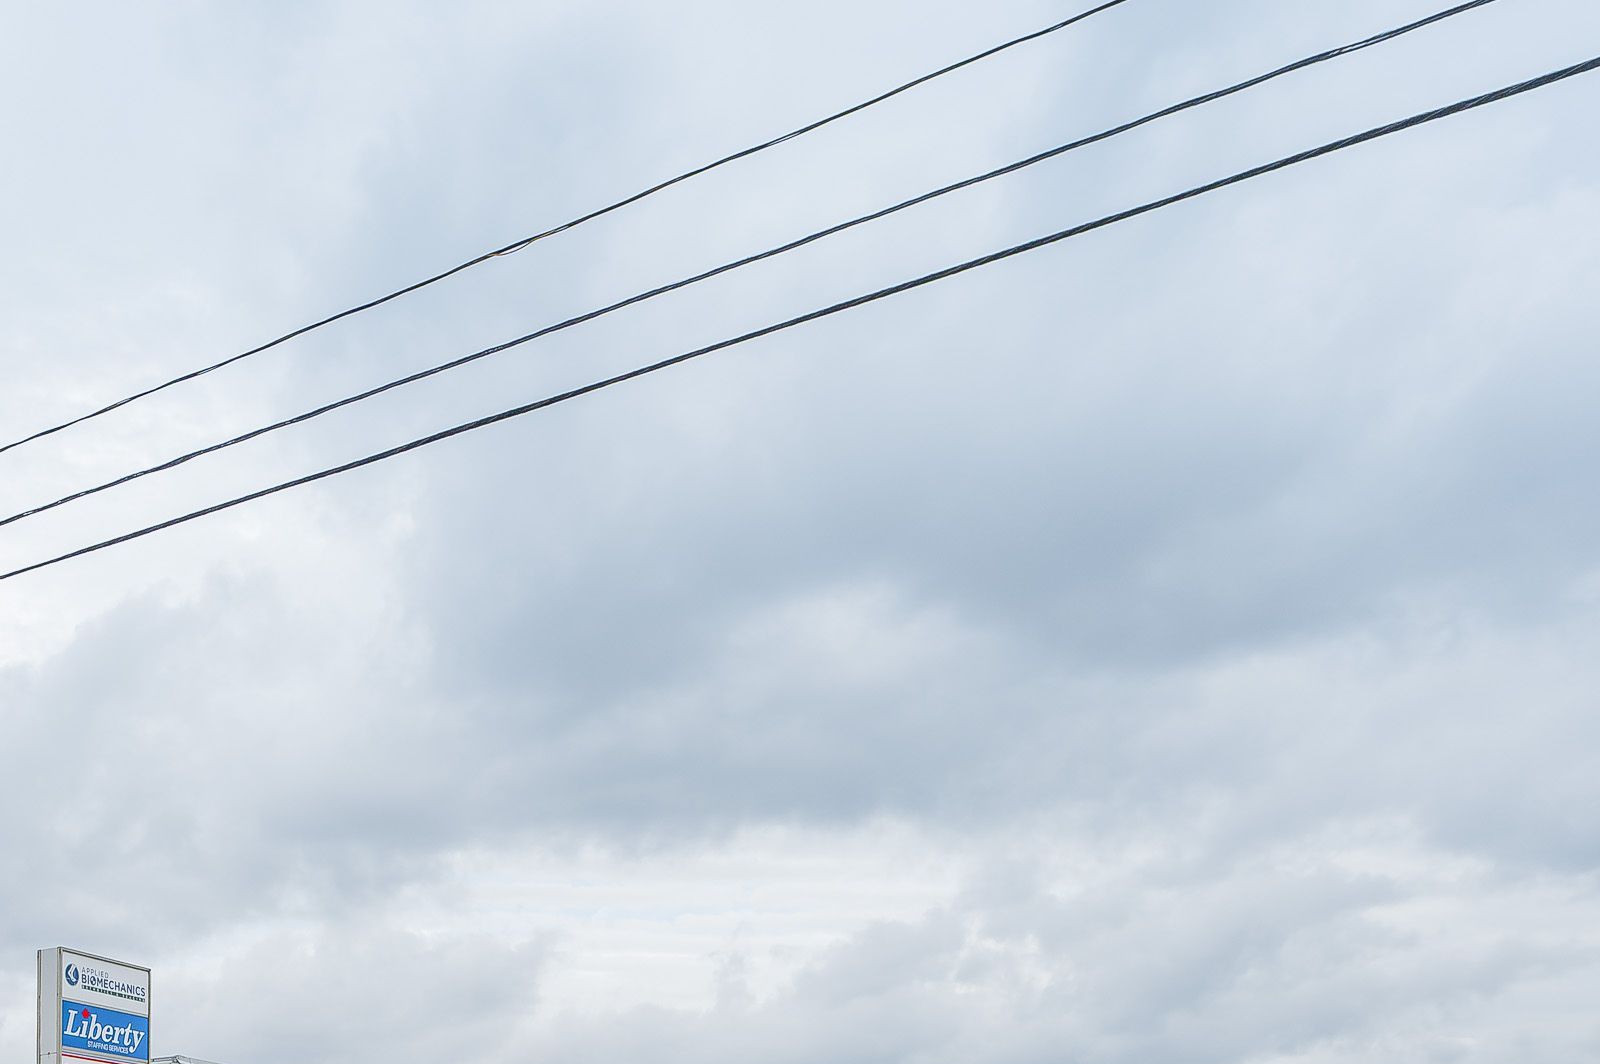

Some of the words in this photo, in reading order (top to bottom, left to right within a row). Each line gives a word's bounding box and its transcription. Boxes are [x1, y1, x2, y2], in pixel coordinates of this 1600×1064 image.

[81, 966, 109, 979] APPLIED
[81, 974, 146, 997] BIOMECHANICS
[63, 1008, 145, 1054] Liberty
